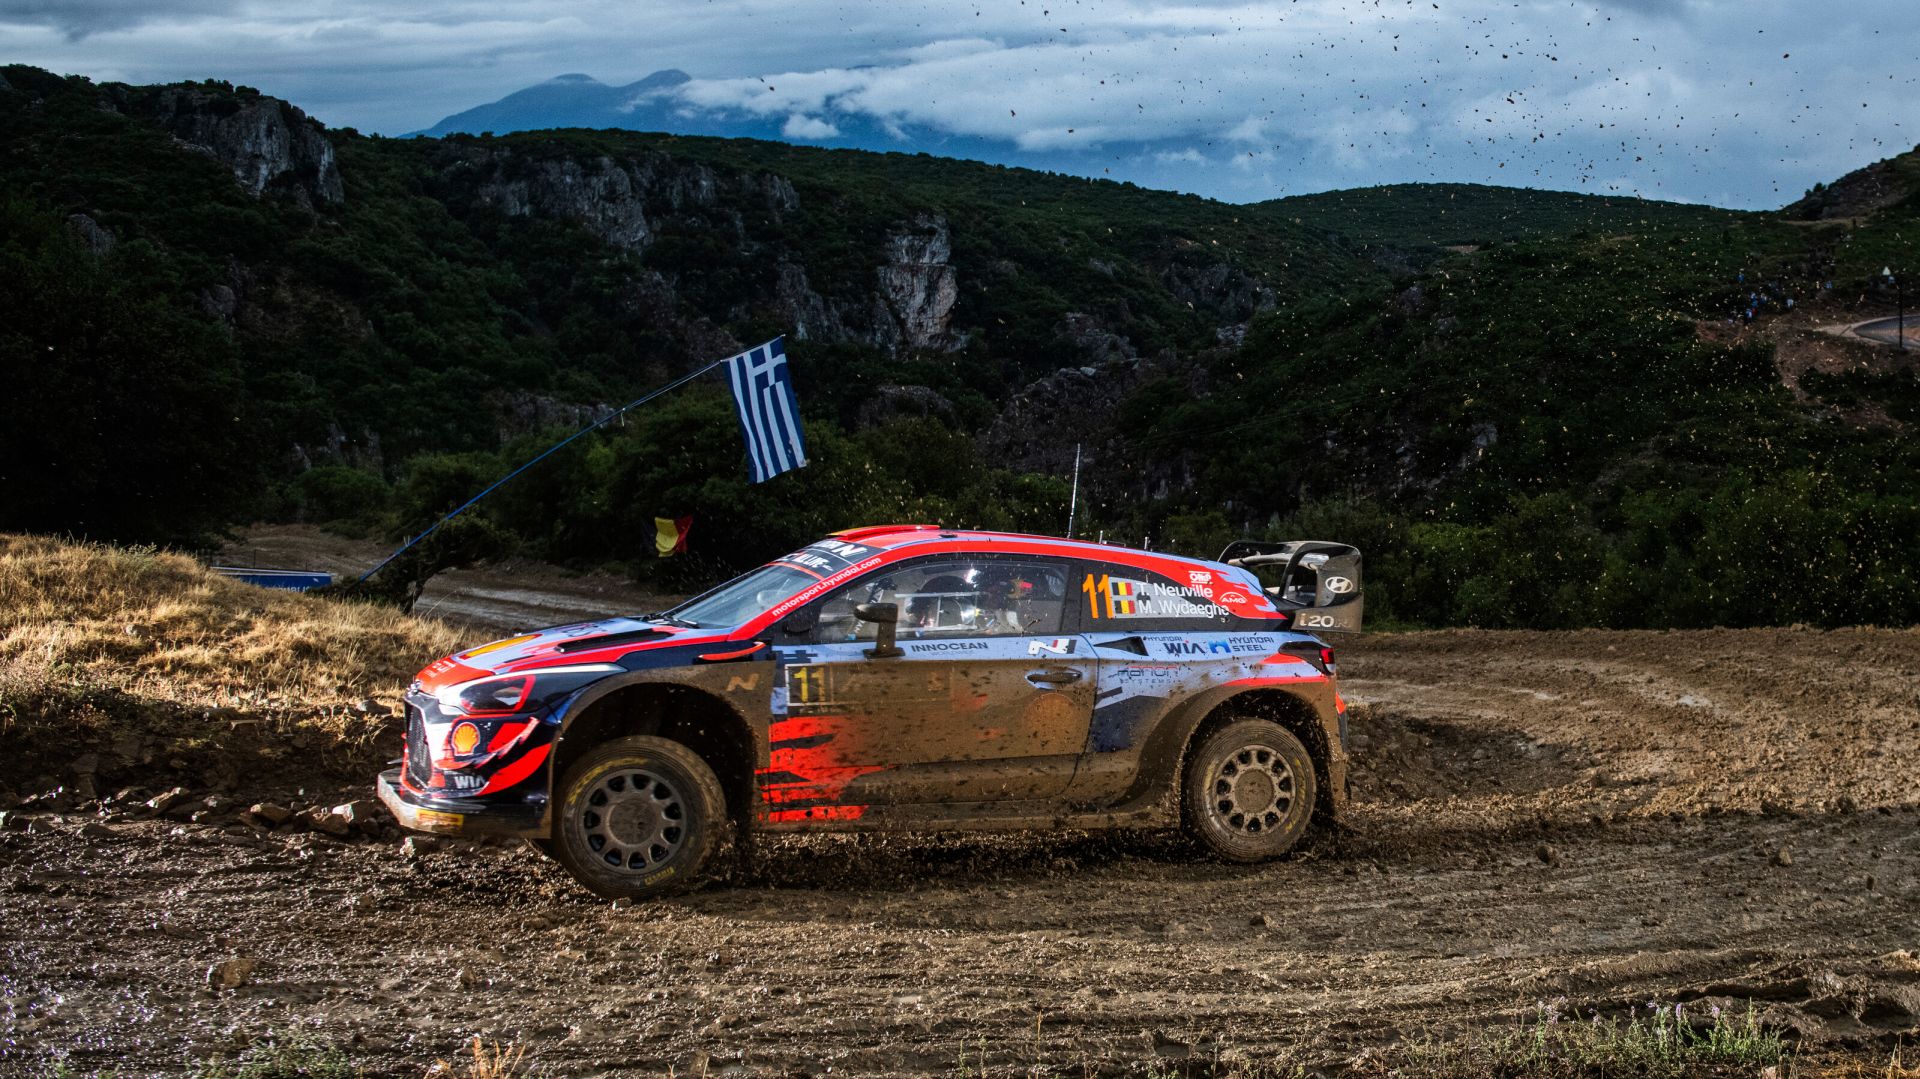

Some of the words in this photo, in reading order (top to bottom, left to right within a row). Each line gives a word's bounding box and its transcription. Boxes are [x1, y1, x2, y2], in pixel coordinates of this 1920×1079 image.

[772, 558, 882, 617] motorsport.hyundai.com
[1083, 573, 1115, 619] 11
[1138, 582, 1150, 597] T.
[1155, 581, 1213, 598] Neuville
[1139, 601, 1156, 614] M.
[1161, 601, 1229, 618] Wydaeghe
[1300, 613, 1333, 627] i20
[911, 642, 988, 652] INNOCEAN
[1228, 636, 1274, 645] HYUNDAI
[793, 667, 825, 703] 11
